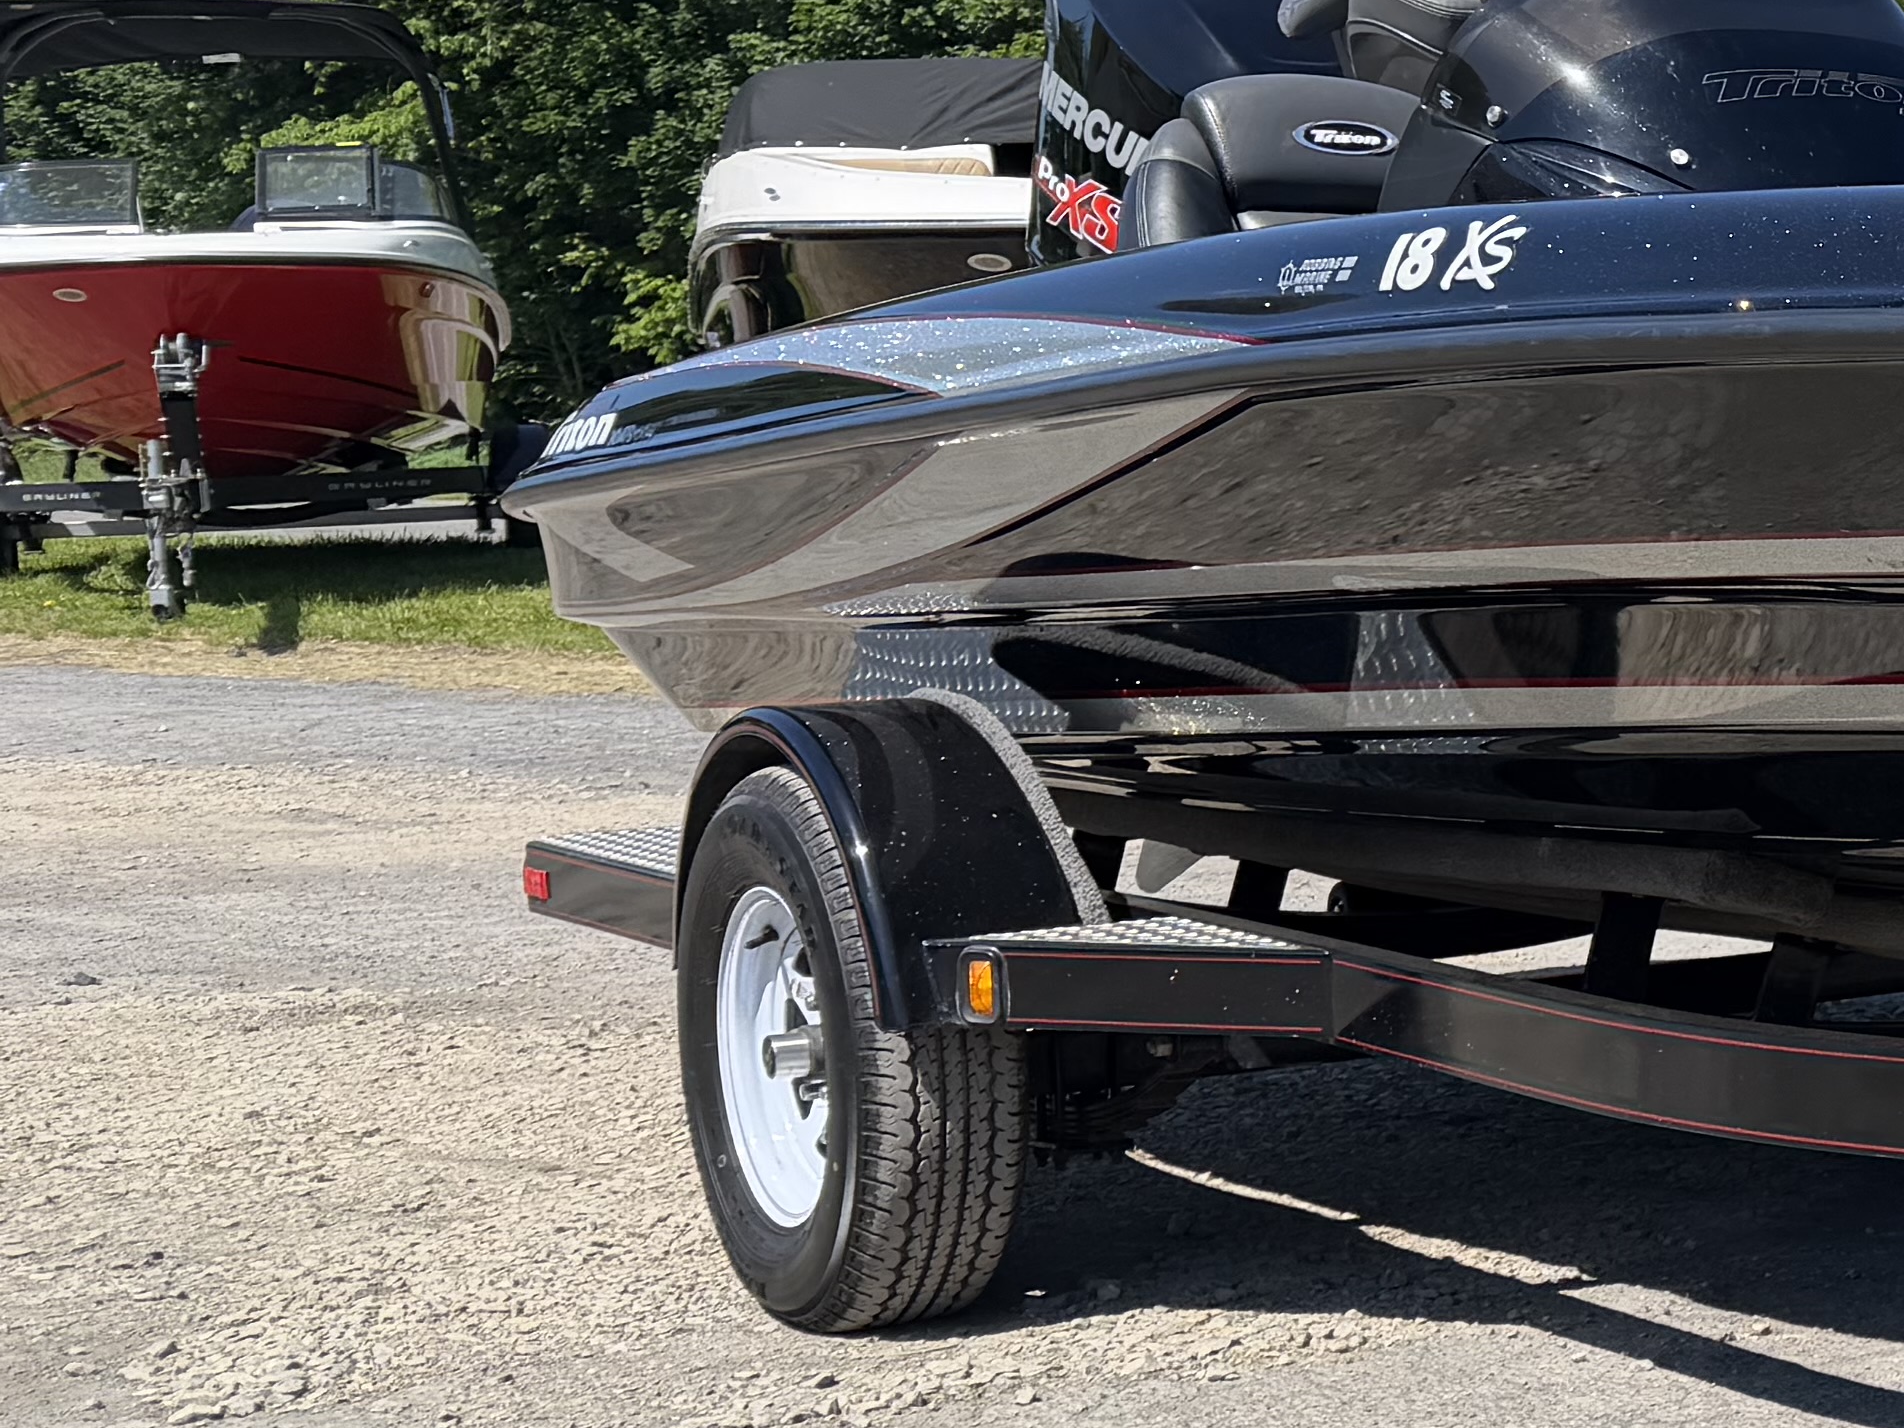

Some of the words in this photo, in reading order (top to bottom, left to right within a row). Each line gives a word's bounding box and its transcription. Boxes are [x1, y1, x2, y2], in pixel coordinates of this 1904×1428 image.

[1310, 129, 1381, 145] Triton
[1379, 227, 1447, 291] 18
[1440, 214, 1527, 291] XS
